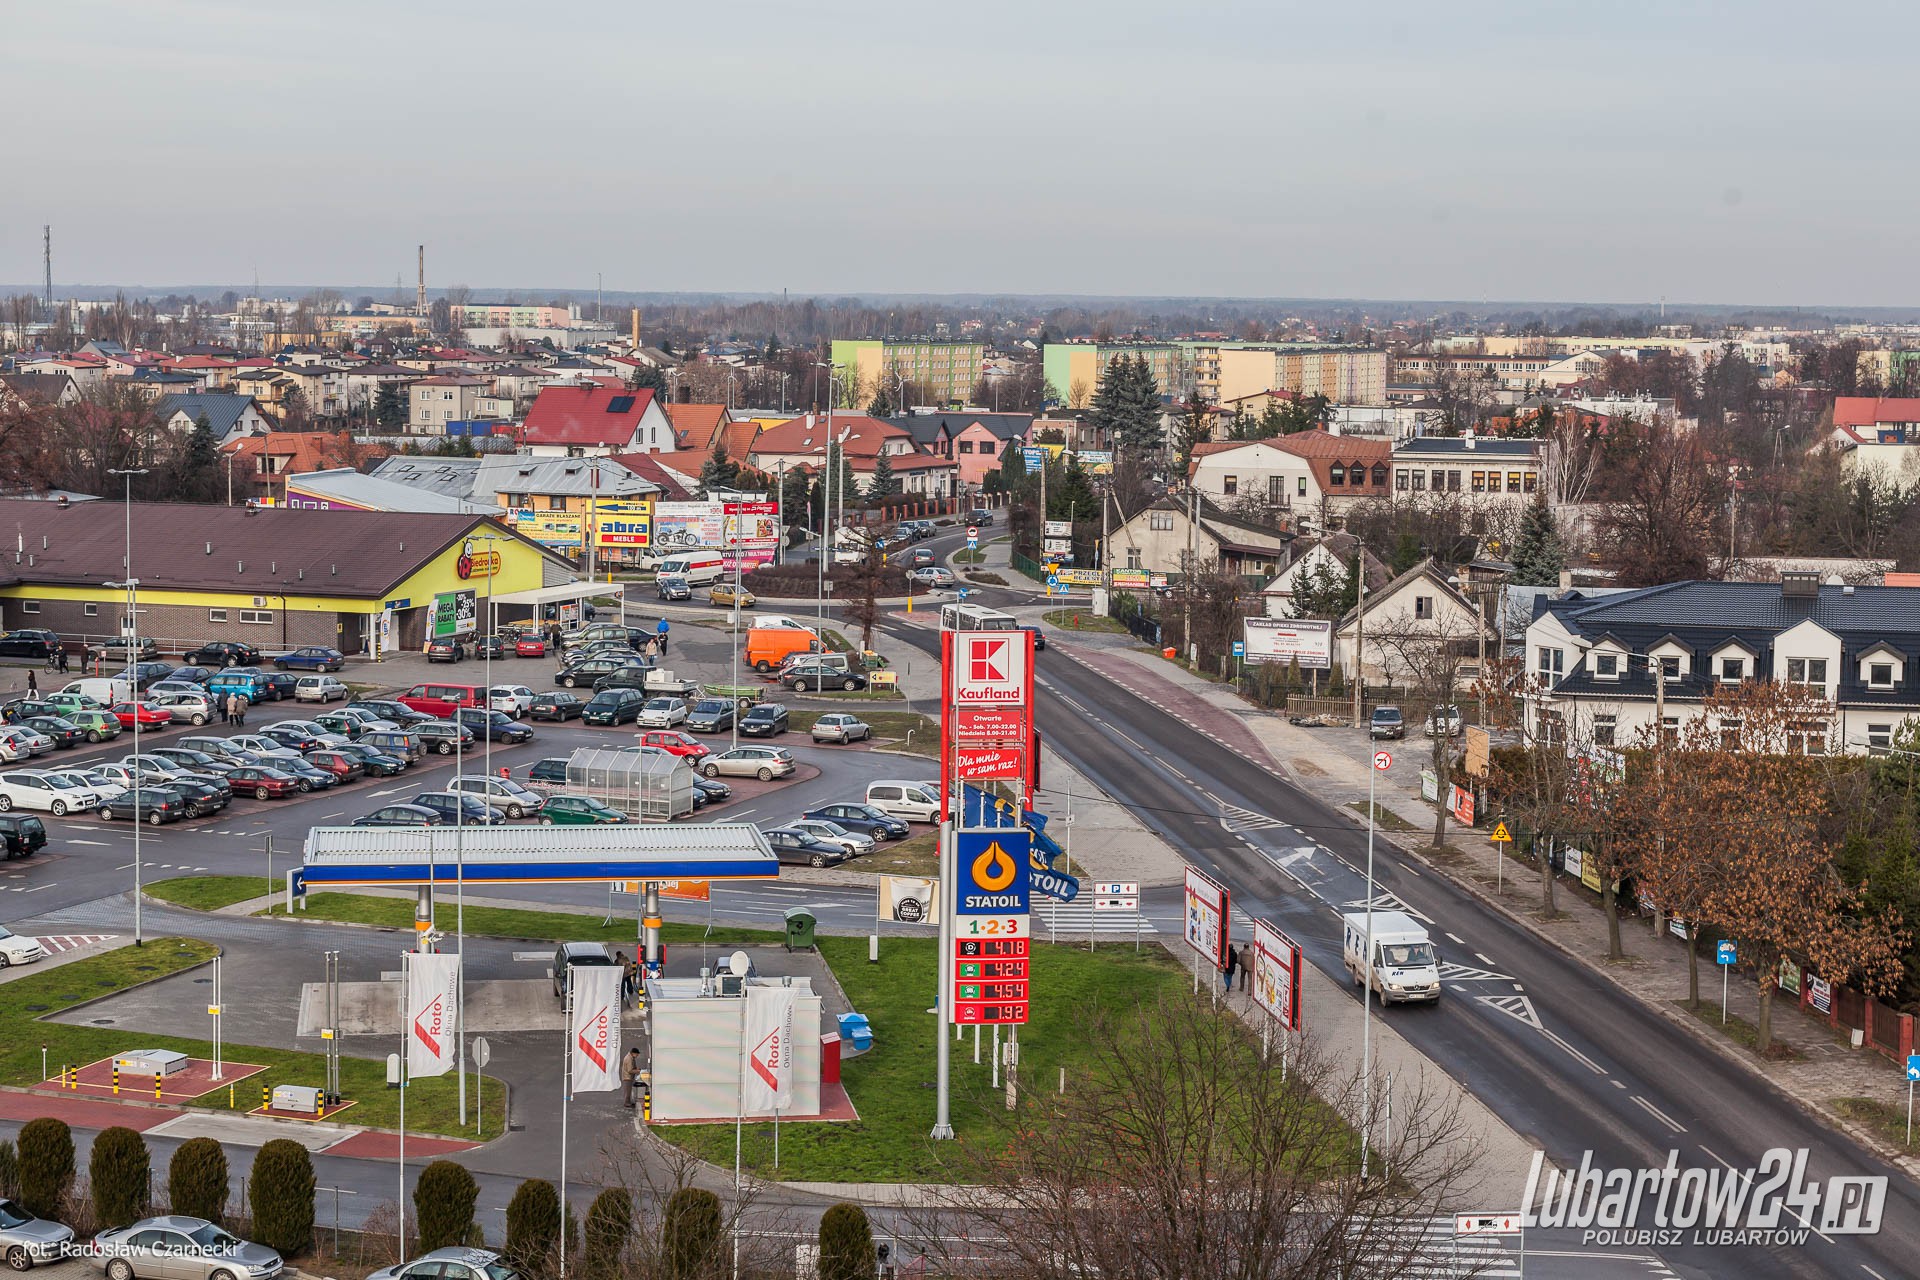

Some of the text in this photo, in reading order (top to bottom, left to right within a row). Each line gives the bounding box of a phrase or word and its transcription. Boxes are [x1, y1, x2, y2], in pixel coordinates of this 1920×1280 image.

[601, 522, 648, 533] abra
[471, 556, 498, 567] Biedroka
[438, 602, 454, 613] MEGA
[461, 598, 474, 608] -25%
[438, 614, 454, 622] RABATY
[457, 607, 471, 619] -30%
[959, 687, 1020, 699] Kaufland
[959, 751, 1000, 767] Dla mnie
[977, 765, 996, 774] sam
[998, 757, 1017, 770] raz!
[966, 896, 1021, 907] STATOIL
[995, 941, 1024, 955] 4.18
[995, 963, 1024, 976] 4.24
[994, 984, 1024, 998] 4.54
[445, 971, 455, 1036] Okna Dachowe
[430, 1002, 442, 1035] Roto
[998, 1006, 1023, 1020] 1.92
[596, 1015, 607, 1048] Roto
[768, 1035, 779, 1068] Roto
